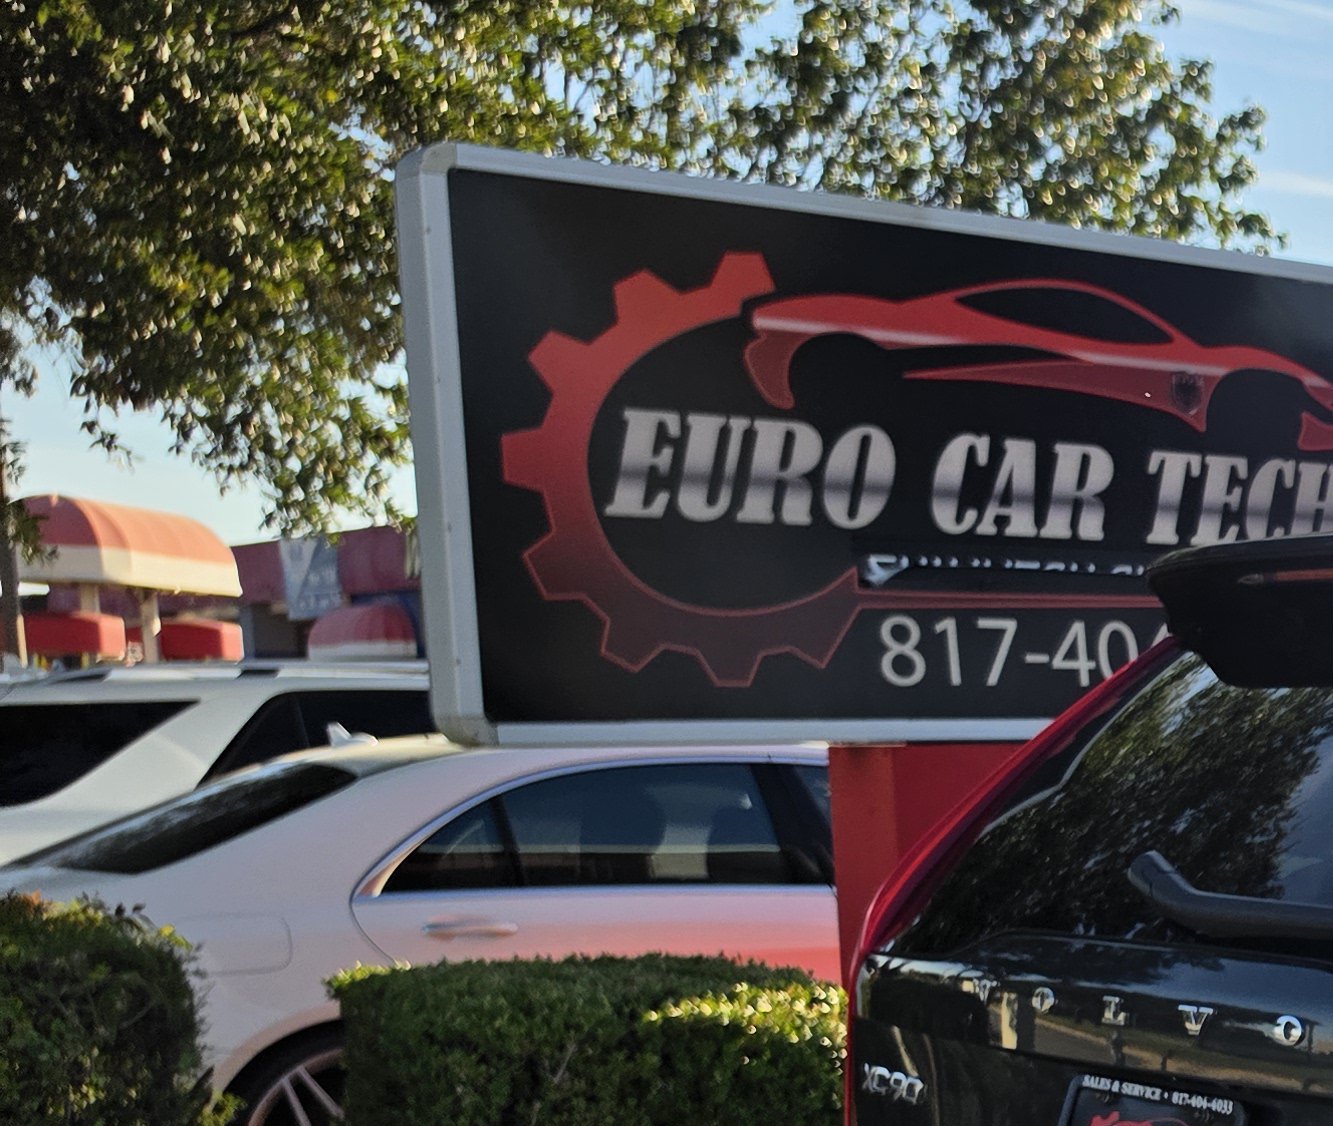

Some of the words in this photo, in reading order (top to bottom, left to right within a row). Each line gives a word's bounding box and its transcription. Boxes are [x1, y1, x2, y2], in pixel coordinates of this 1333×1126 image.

[604, 407, 897, 530] EURO
[931, 432, 1115, 541] CAR
[879, 614, 1172, 688] 817-40
[972, 977, 1303, 1046] VOLVO
[862, 1063, 924, 1105] XC90
[1082, 1075, 1111, 1091] SALES
[1121, 1082, 1162, 1101] SERVICE
[1171, 1091, 1234, 1115] 817-404-4033
